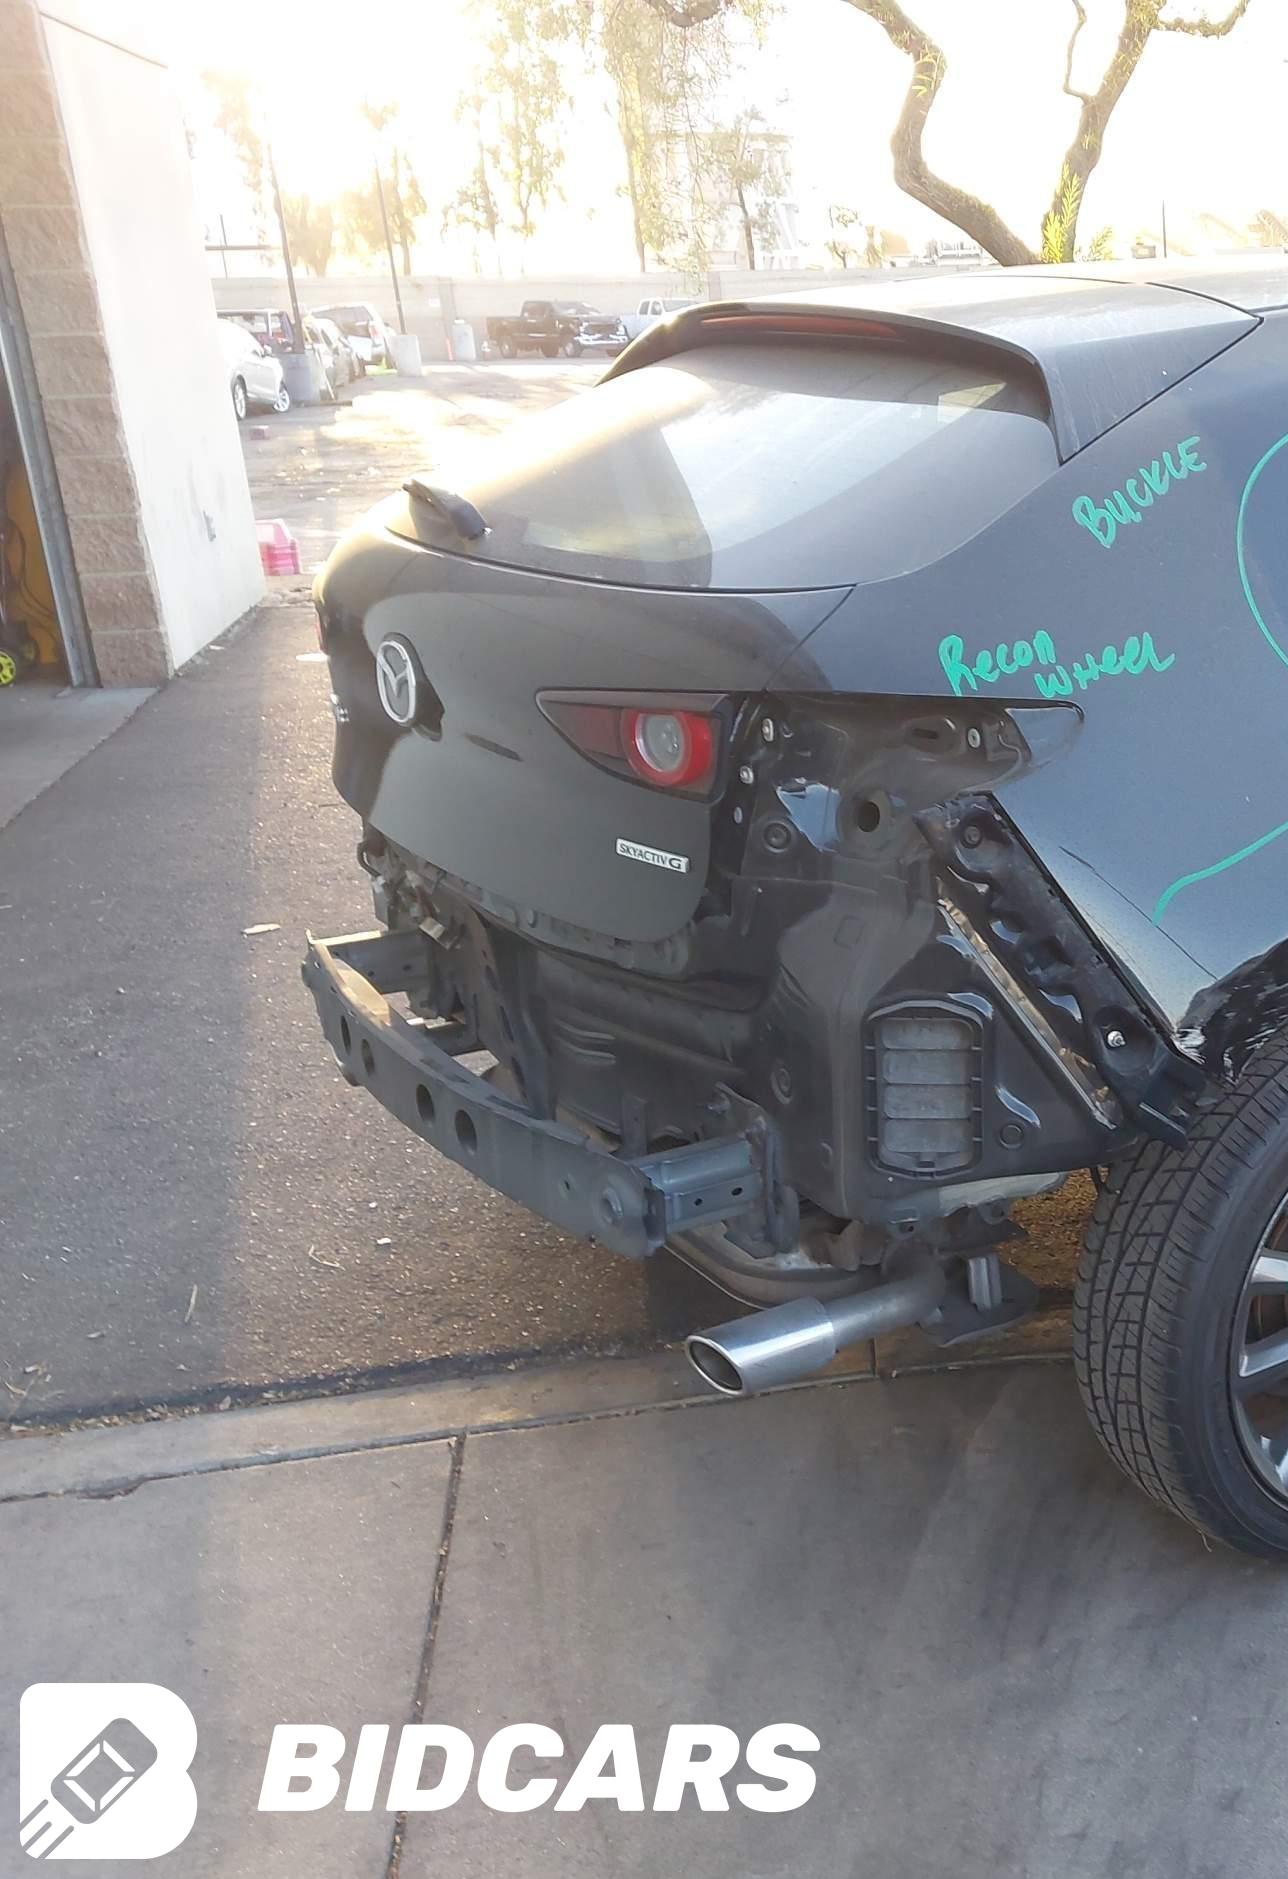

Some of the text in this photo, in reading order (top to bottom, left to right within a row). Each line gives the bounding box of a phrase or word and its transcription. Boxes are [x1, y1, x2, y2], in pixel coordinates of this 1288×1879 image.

[1072, 436, 1207, 548] BUCKLE
[620, 843, 682, 869] SKYACTIV G
